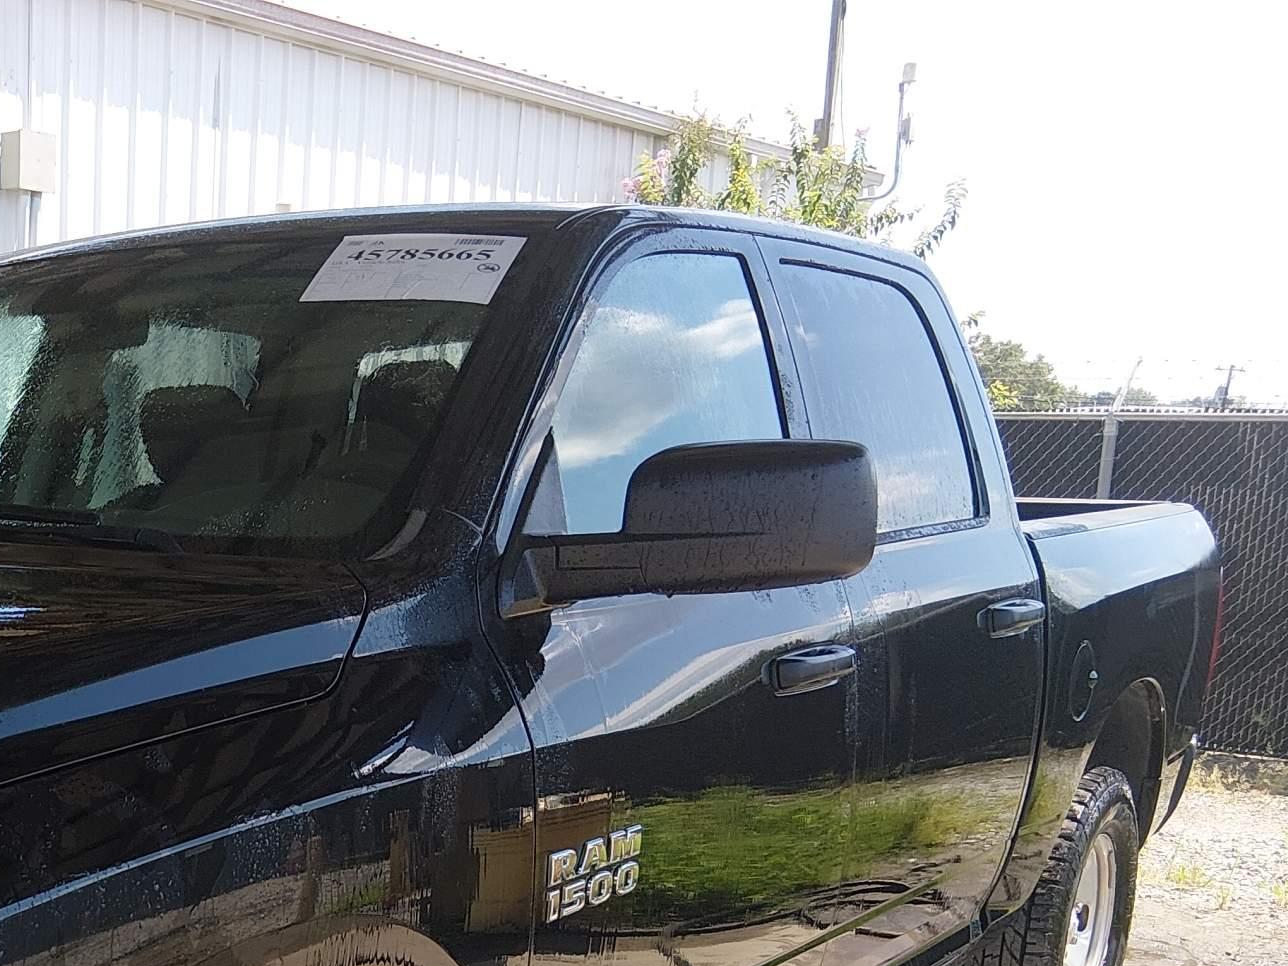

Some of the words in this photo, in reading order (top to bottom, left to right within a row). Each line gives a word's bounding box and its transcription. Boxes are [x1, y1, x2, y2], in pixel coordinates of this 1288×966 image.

[347, 249, 496, 261] 45785665
[545, 824, 643, 889] RAM
[545, 860, 640, 924] 1500
